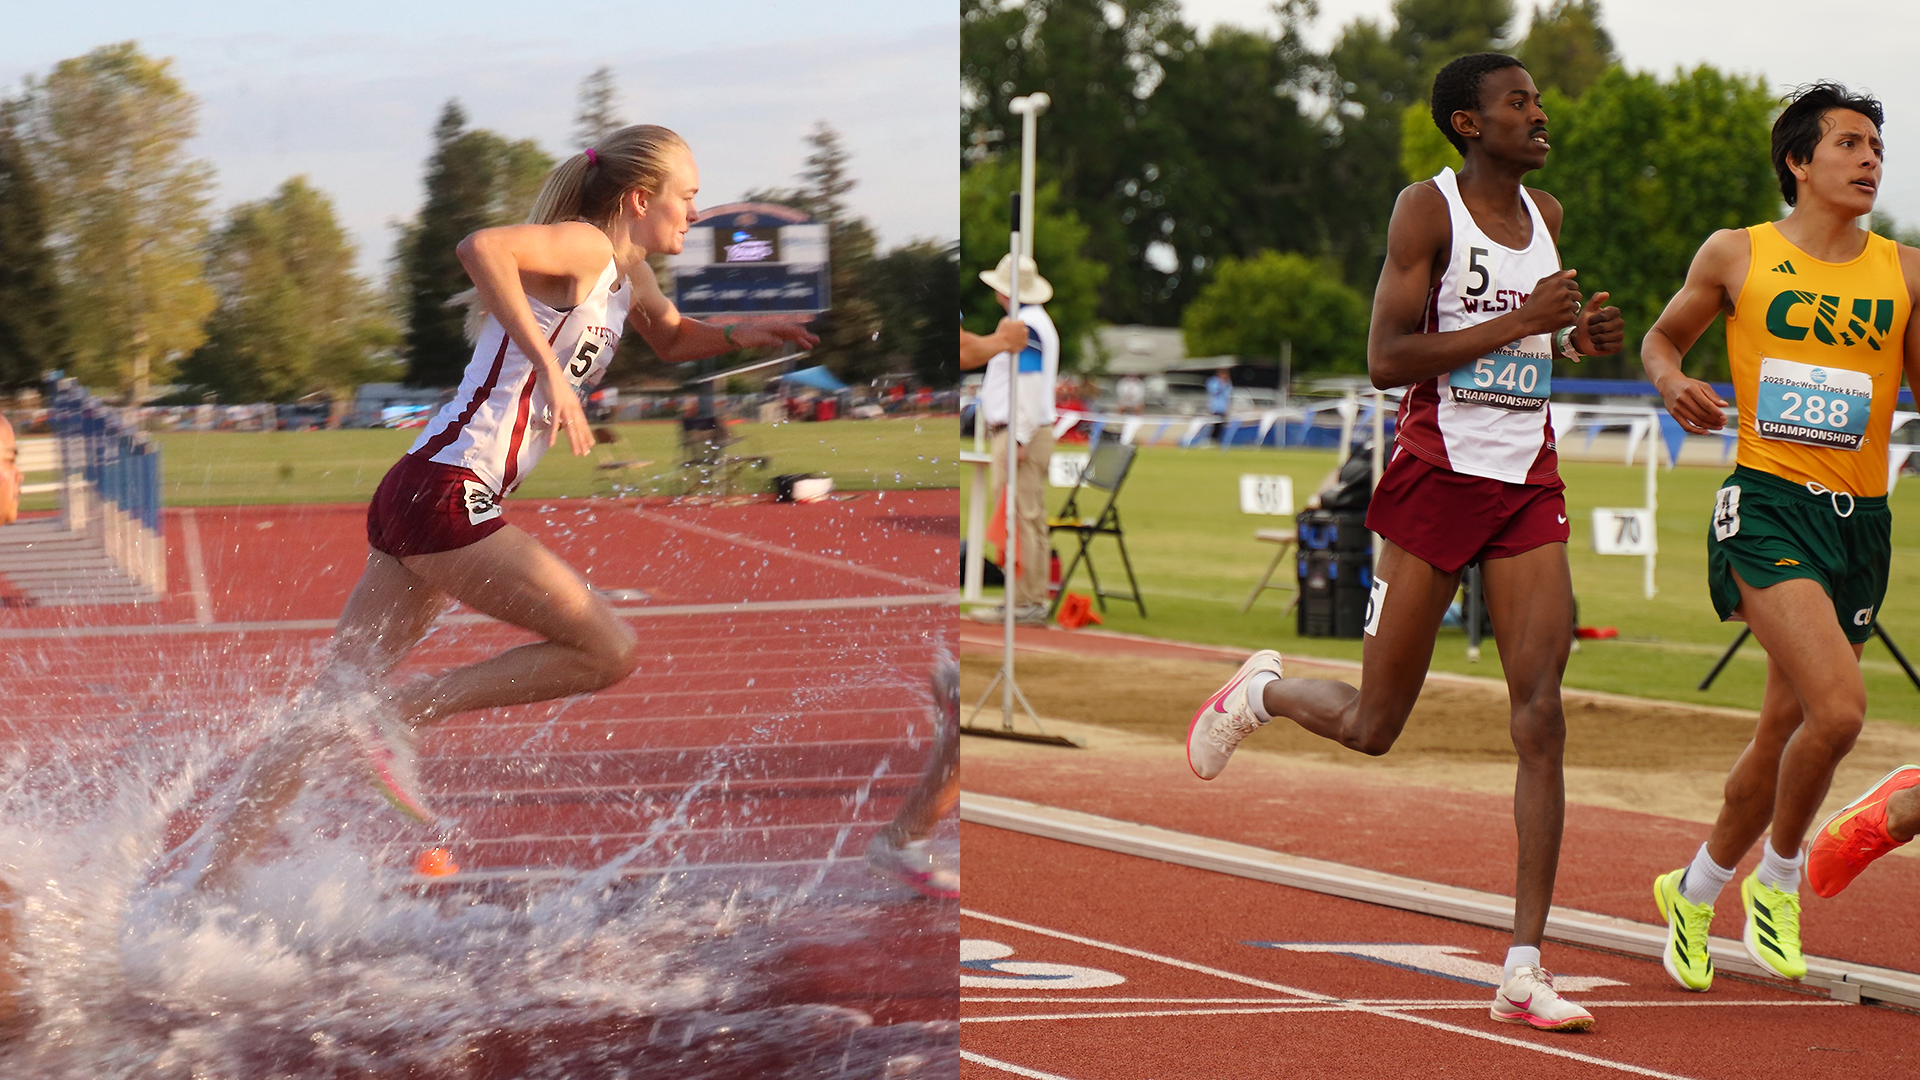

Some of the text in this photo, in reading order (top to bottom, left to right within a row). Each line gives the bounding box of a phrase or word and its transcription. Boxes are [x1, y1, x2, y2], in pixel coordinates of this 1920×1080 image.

[1466, 246, 1490, 297] 5
[570, 340, 600, 378] 5
[1516, 350, 1534, 358] Track
[1473, 358, 1538, 394] 540
[1763, 375, 1784, 385] 2025
[1786, 378, 1821, 390] PacWest
[1822, 384, 1843, 394] Track
[1852, 389, 1870, 399] Field
[1456, 388, 1543, 407] CHAMPIONSHIPS
[1780, 392, 1849, 428] 288
[1762, 422, 1858, 445] CHAMPIONSHIPS
[1611, 512, 1641, 546] 70
